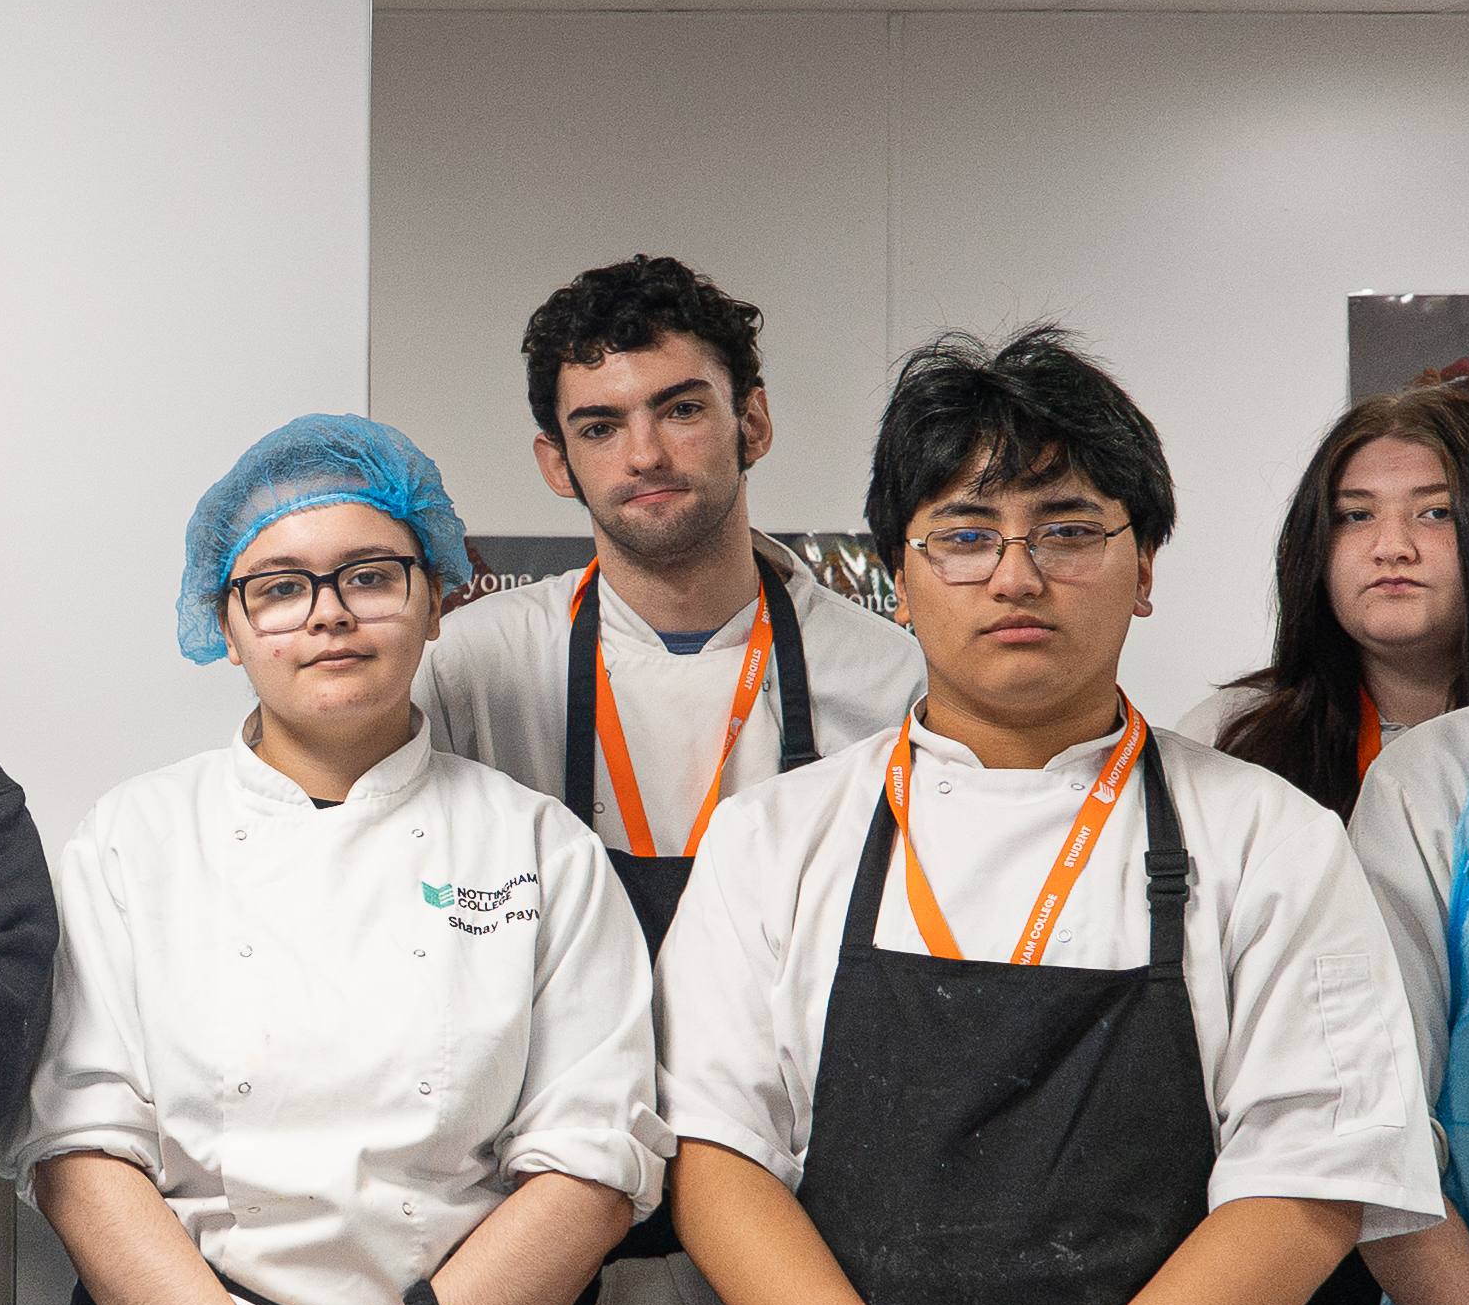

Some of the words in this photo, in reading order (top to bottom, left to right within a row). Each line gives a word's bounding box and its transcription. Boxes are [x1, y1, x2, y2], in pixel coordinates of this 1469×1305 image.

[744, 648, 762, 691] STUDENT
[891, 766, 904, 808] STUDENT
[1063, 825, 1092, 869] STUDENT
[457, 873, 539, 901] NOTTINGHAM
[458, 891, 512, 912] COLLEGE
[448, 916, 499, 936] Shanay
[1030, 893, 1059, 941] COLLEGE
